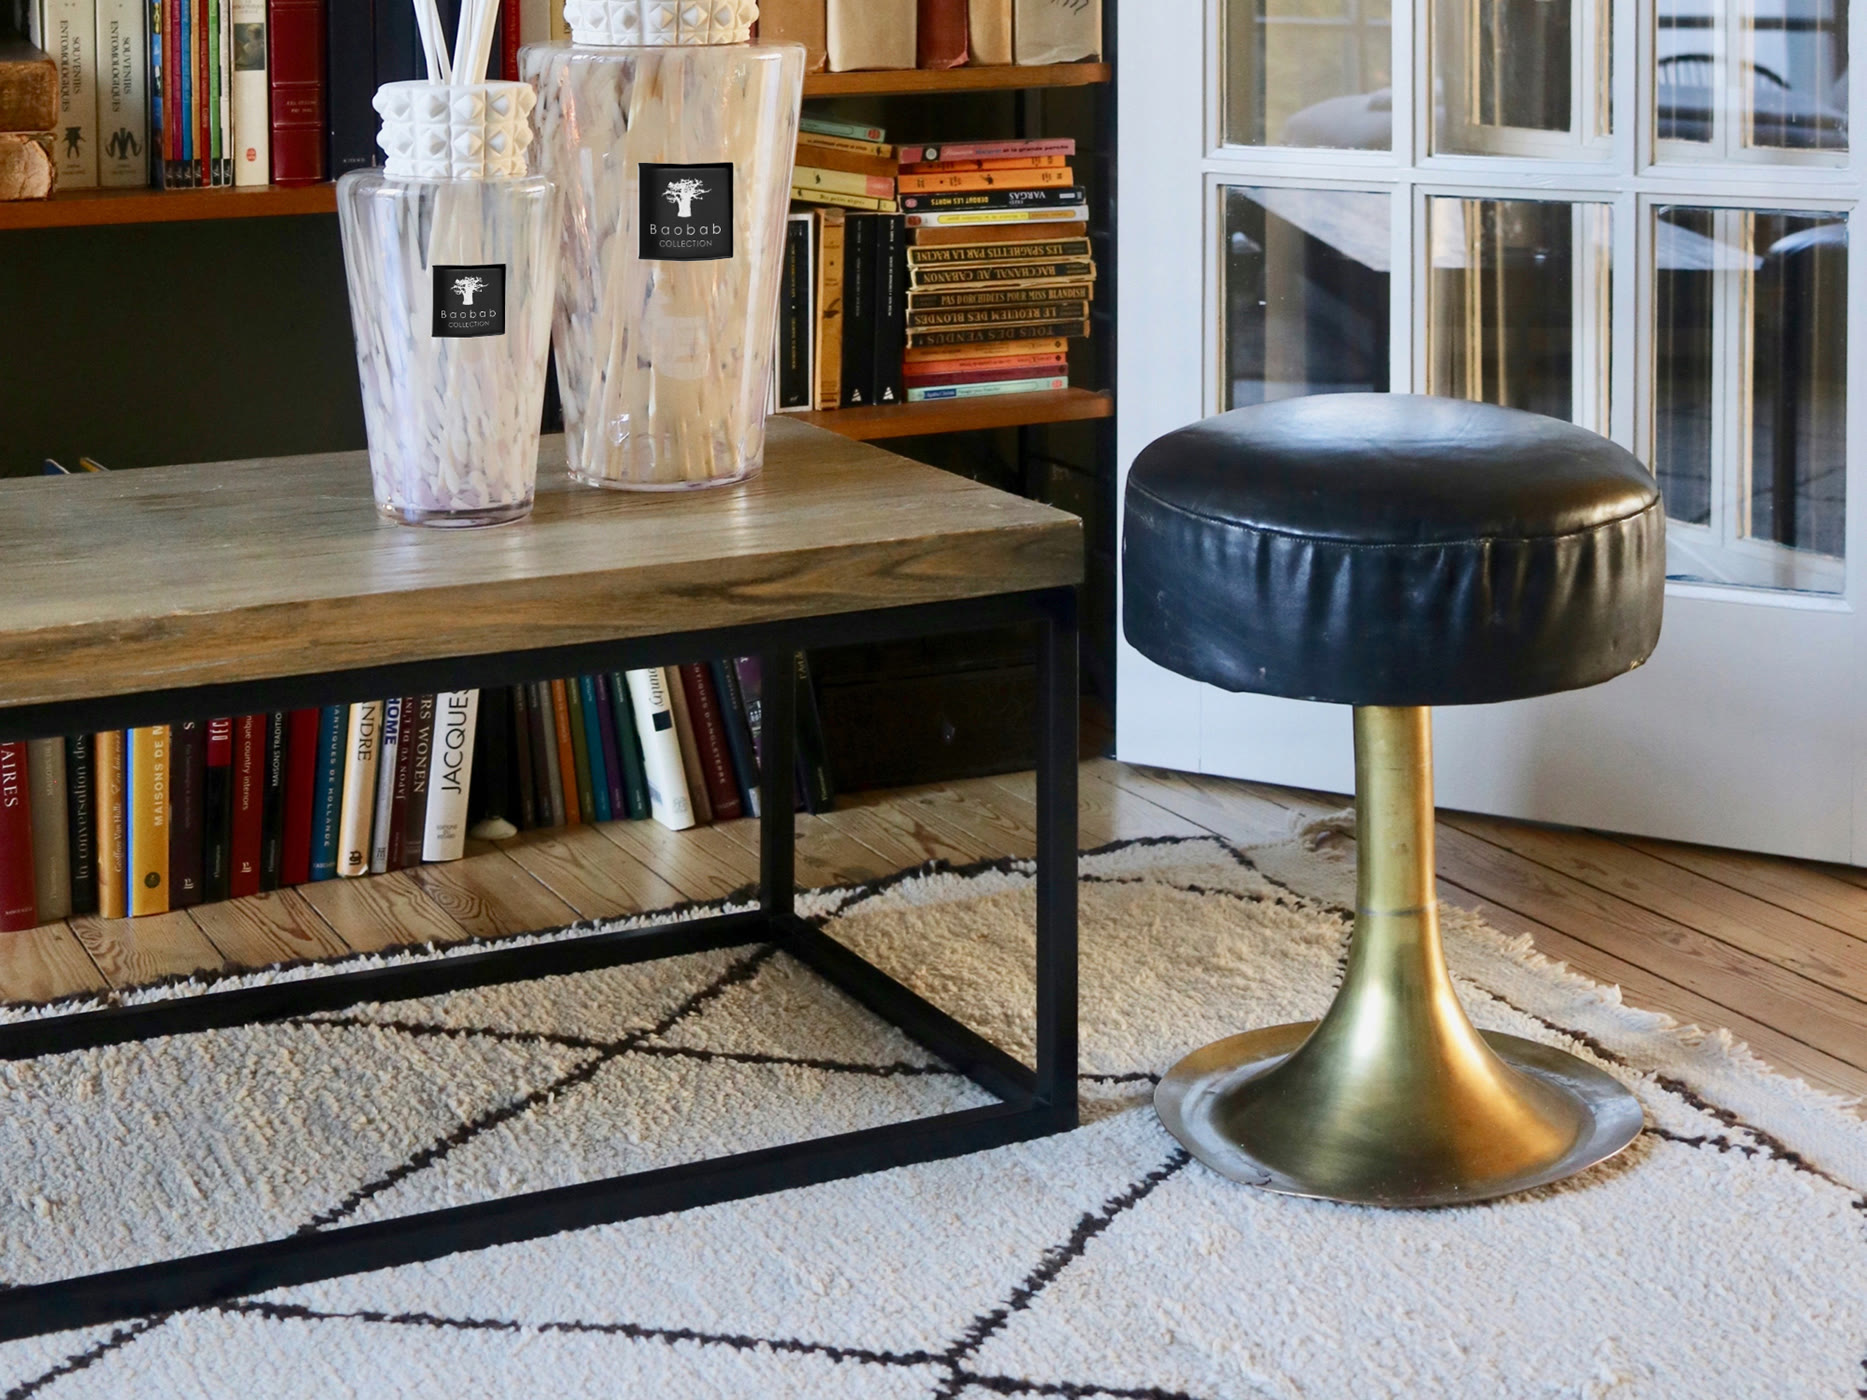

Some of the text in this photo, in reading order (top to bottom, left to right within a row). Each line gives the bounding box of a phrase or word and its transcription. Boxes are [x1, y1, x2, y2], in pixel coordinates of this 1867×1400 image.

[60, 20, 70, 112] ENTOMOLOGIQUES
[73, 36, 81, 94] SOUVENIRS
[110, 20, 120, 112] ENTOMOLOGIQUES
[123, 36, 132, 94] SOUVENIRS
[1009, 191, 1046, 200] VARGAS
[649, 222, 722, 236] Baobab
[658, 238, 713, 248] COLLECTION
[916, 245, 1063, 262] LES SPAGHETTIS PAR LA RACINE
[922, 265, 1056, 283] BACCHANAL AU CABANON
[1048, 286, 1086, 299] BLANDISH
[440, 307, 497, 320] Baobab
[448, 320, 490, 329] COLLECTION
[914, 307, 1056, 325] LE REQUIEM DES BLONDES
[927, 326, 1054, 344] TOUS DES VENDUS
[647, 666, 665, 708] ountry
[241, 714, 253, 810] nique country interiors
[272, 751, 280, 786] MAISONS
[413, 726, 430, 793] WONEN
[153, 741, 164, 826] MAISONS DE
[396, 766, 407, 799] JAPON
[75, 767, 89, 860] conversation
[323, 769, 335, 846] DE HOLLANDE
[76, 866, 89, 879] la
